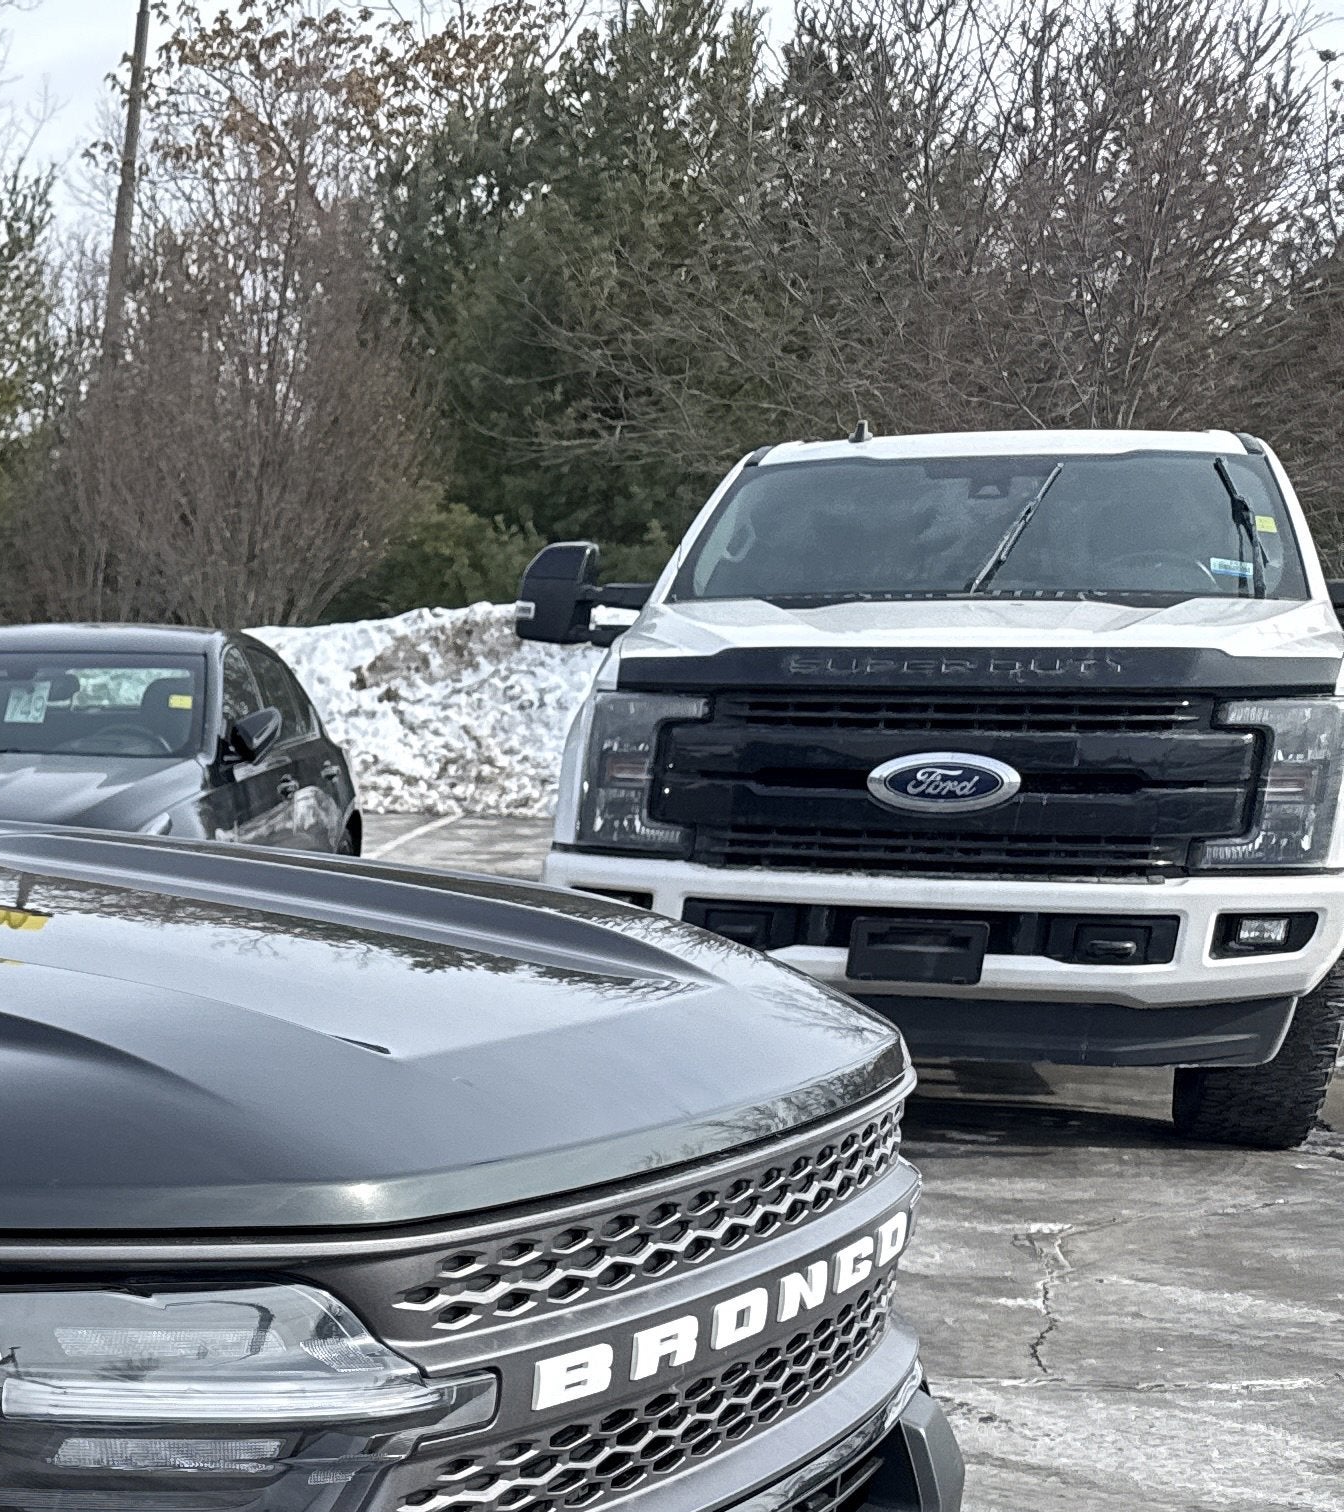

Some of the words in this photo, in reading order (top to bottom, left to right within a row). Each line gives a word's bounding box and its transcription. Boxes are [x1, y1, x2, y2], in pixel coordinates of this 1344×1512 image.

[789, 656, 978, 675] SUPER
[989, 655, 1126, 676] DUTY
[906, 765, 977, 798] Ford
[530, 1210, 909, 1412] BRONCO
